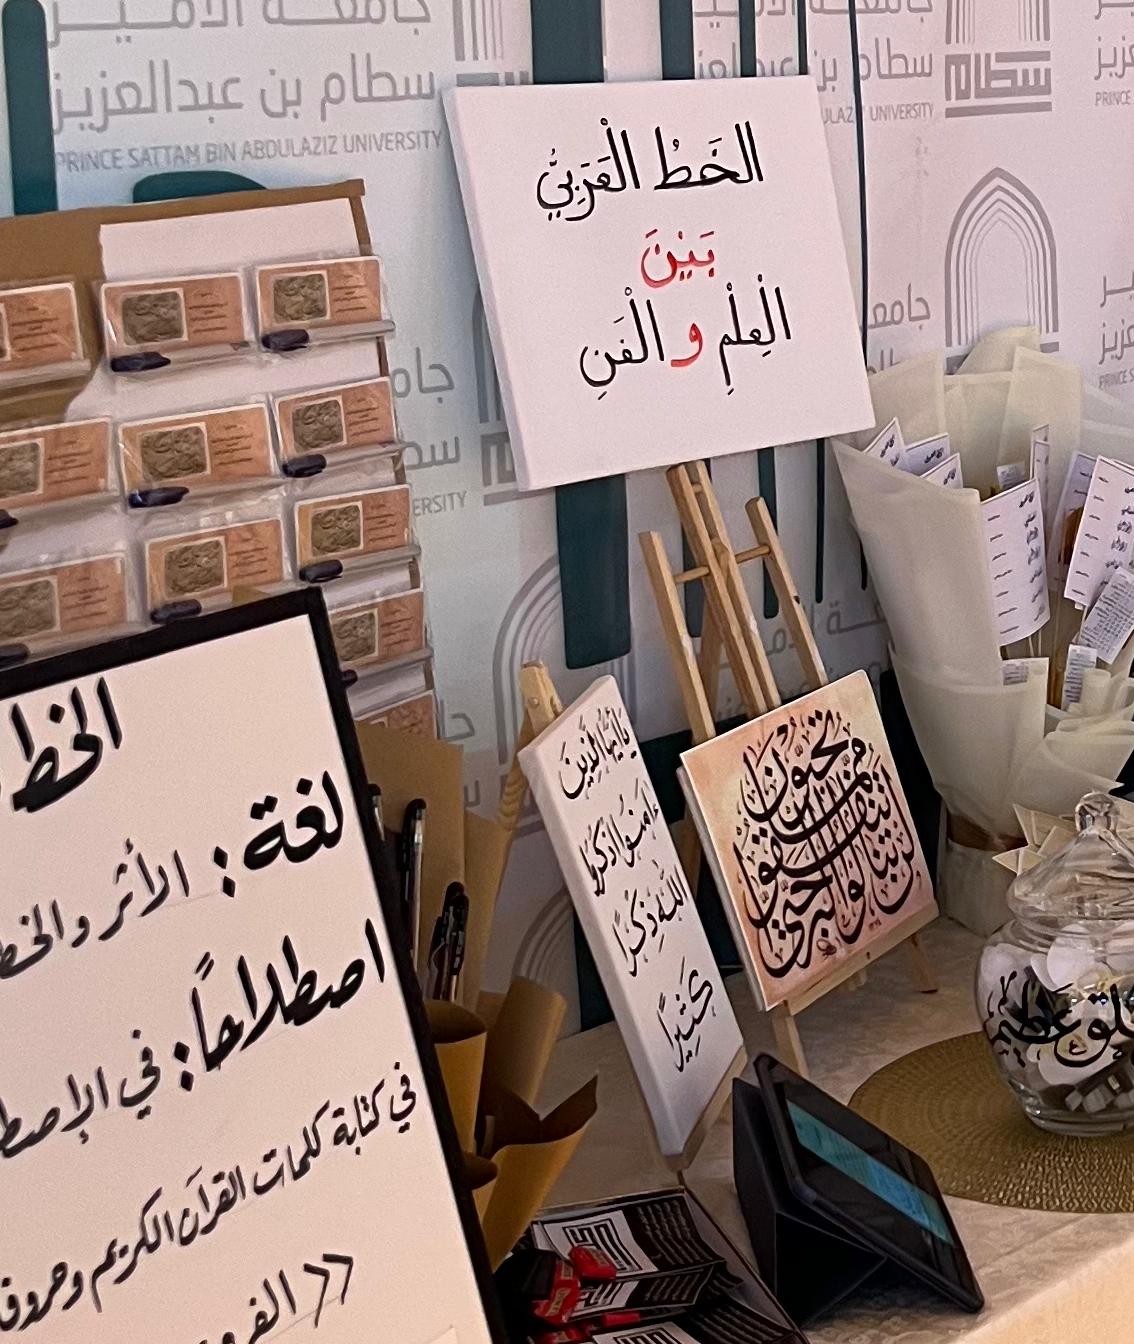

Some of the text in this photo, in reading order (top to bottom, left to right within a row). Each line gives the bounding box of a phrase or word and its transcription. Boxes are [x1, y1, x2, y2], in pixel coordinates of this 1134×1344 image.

[49, 51, 435, 136] سطام بن عبدالعزيز
[869, 102, 934, 122] UNIVERSITY
[671, 322, 704, 368] و
[10, 676, 123, 813] الخط
[98, 836, 190, 942] الأثر
[120, 1029, 161, 1120] في
[333, 1077, 386, 1156] كتابة
[390, 1061, 417, 1134] في
[252, 1100, 331, 1196] كلمات
[180, 1166, 248, 1247] القرآن
[91, 1186, 175, 1314] الكريم
